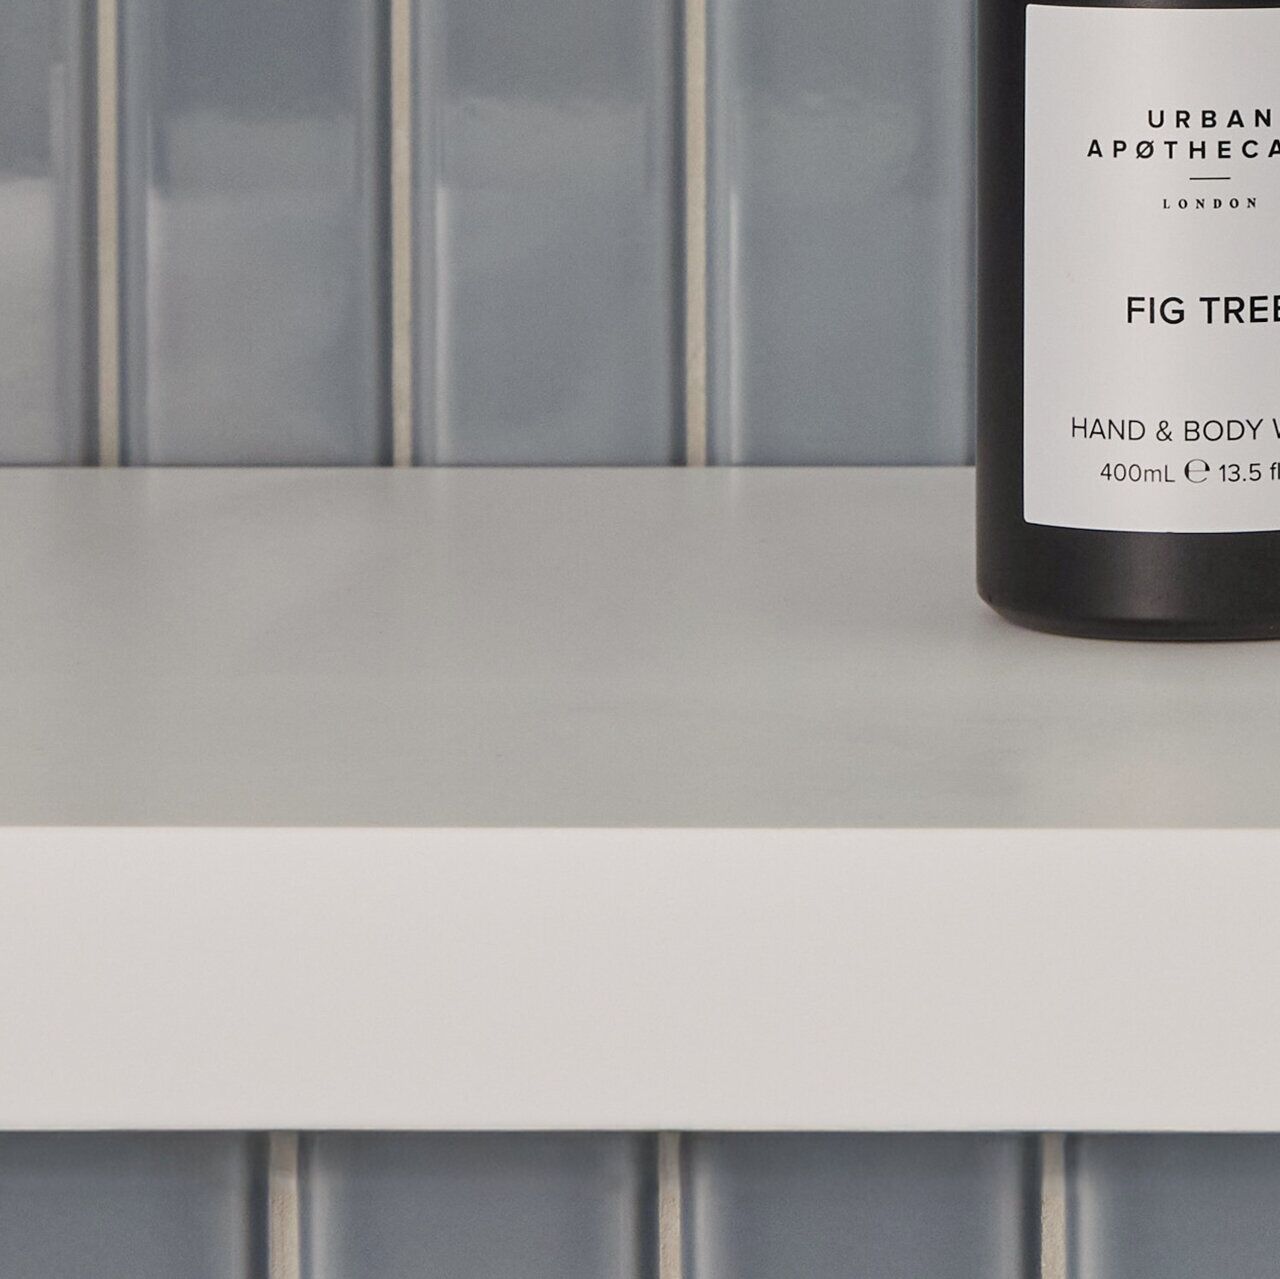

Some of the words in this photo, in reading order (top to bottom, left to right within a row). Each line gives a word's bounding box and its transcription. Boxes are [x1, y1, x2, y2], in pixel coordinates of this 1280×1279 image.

[1147, 108, 1272, 129] URBAN
[1162, 197, 1257, 210] LONDON
[1127, 296, 1185, 325] FIG
[1071, 416, 1146, 441] HAND
[1155, 419, 1173, 442] &
[1184, 418, 1264, 442] BODY
[1099, 462, 1176, 483] 400mL
[1218, 462, 1262, 483] 13.5
